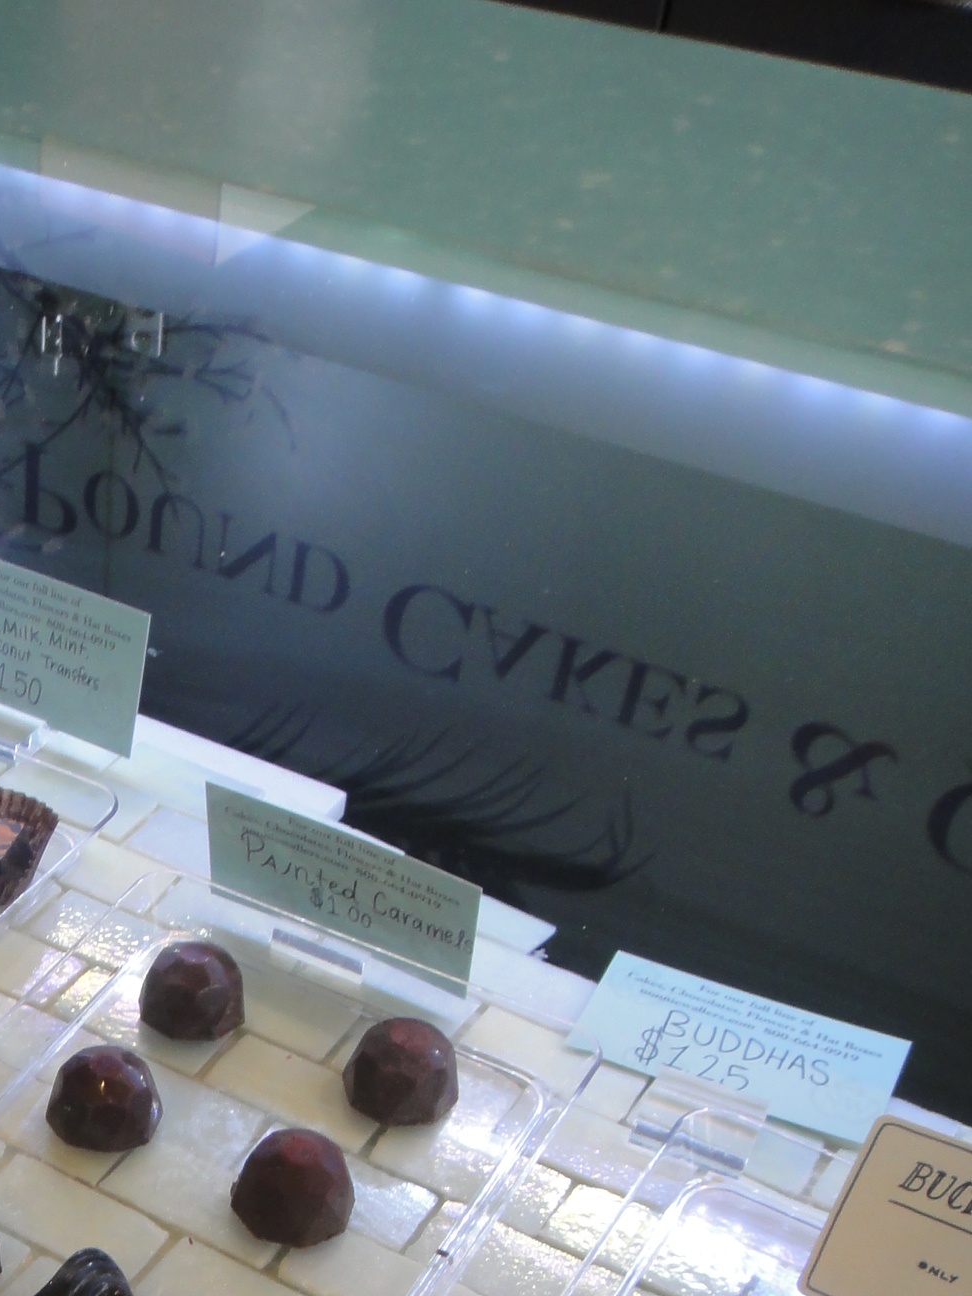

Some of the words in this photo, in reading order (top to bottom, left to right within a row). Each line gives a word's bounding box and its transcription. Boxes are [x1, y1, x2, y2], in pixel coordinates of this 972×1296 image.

[40, 652, 100, 691] Transfers
[660, 1009, 830, 1086] BUDDHAS
[917, 1260, 960, 1284] ONLY
